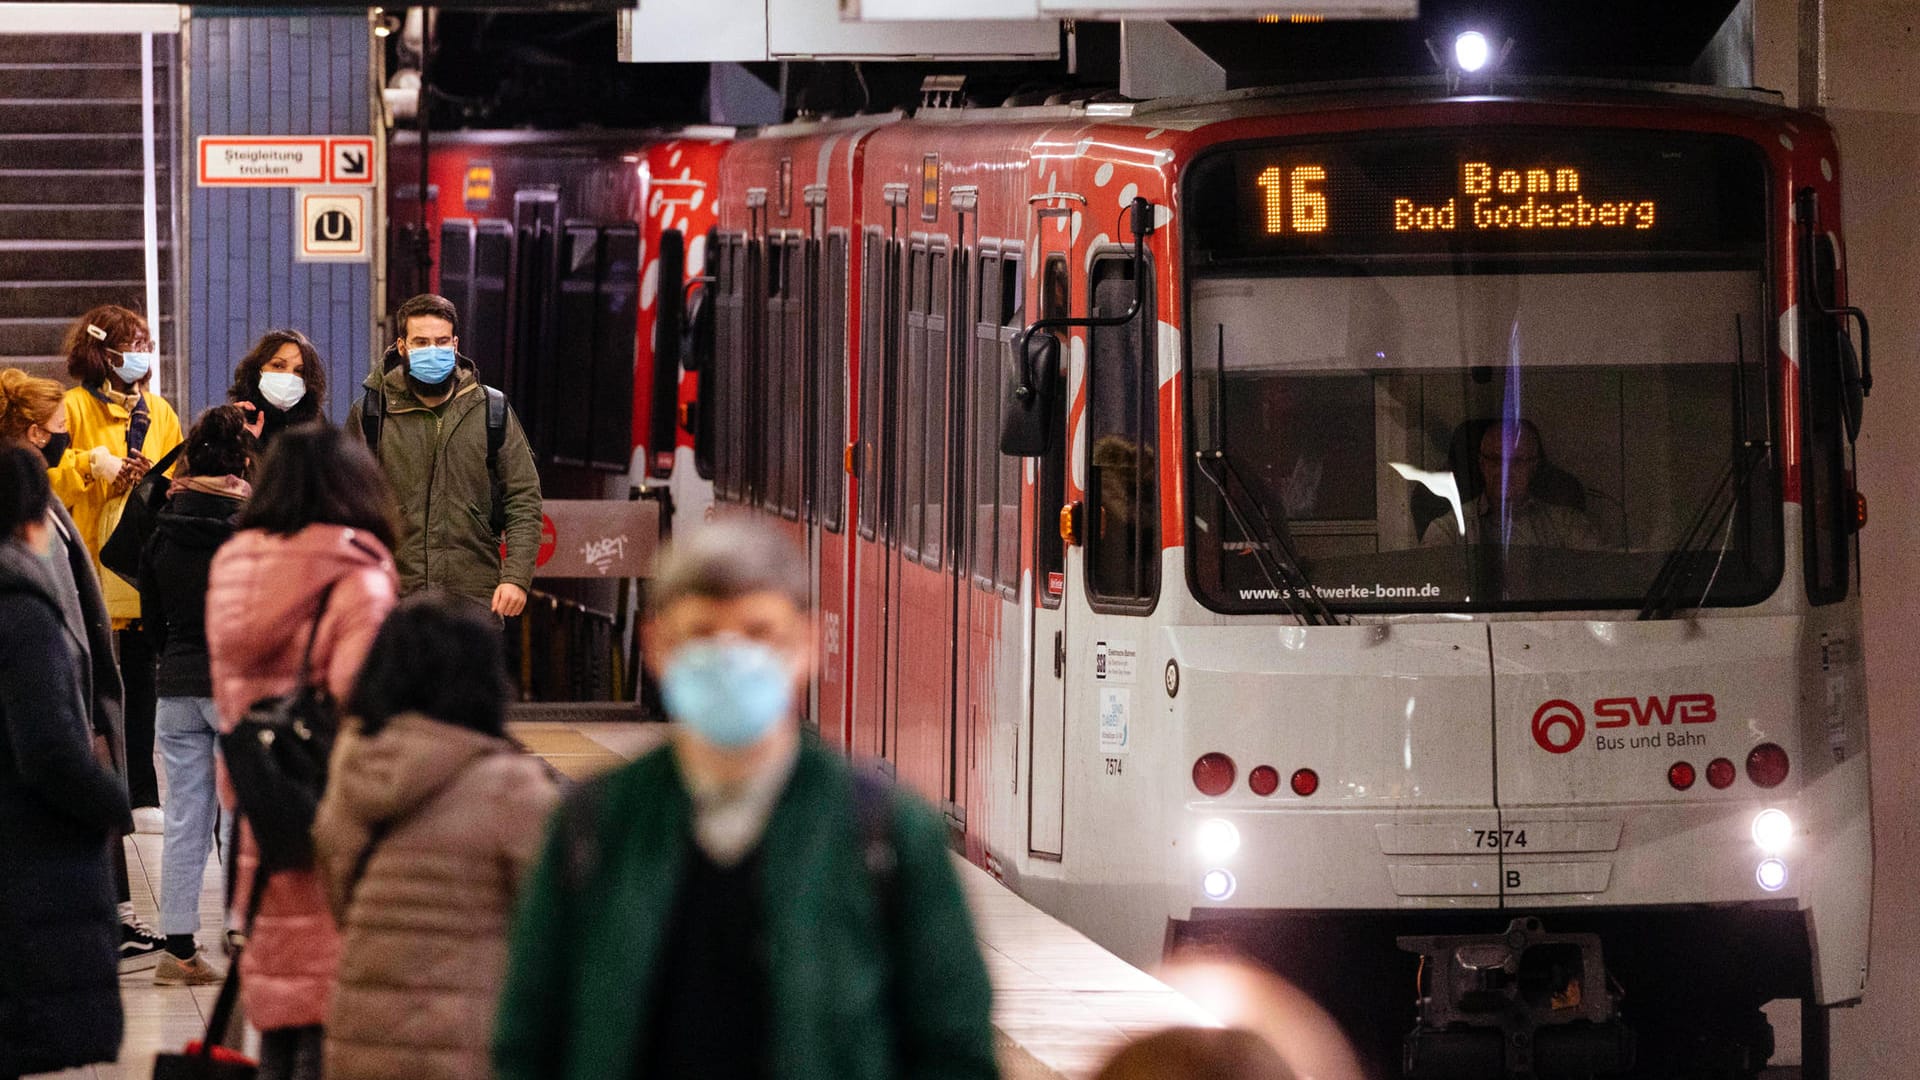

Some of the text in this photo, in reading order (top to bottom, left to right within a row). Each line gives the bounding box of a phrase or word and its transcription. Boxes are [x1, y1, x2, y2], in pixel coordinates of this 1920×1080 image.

[225, 150, 303, 163] Steigleitung
[239, 165, 289, 175] trocken
[1465, 162, 1580, 194] Bonn
[1258, 166, 1327, 233] 16
[1395, 195, 1655, 230] Bad Godesberg
[323, 213, 345, 240] U
[1239, 583, 1440, 600] www.sadtwerke-bonn.de
[1594, 694, 1717, 728] SWB
[1596, 731, 1706, 750] Bus und Bahn
[1105, 758, 1122, 776] 7574
[1474, 830, 1527, 848] 7574
[1506, 871, 1521, 888] B
